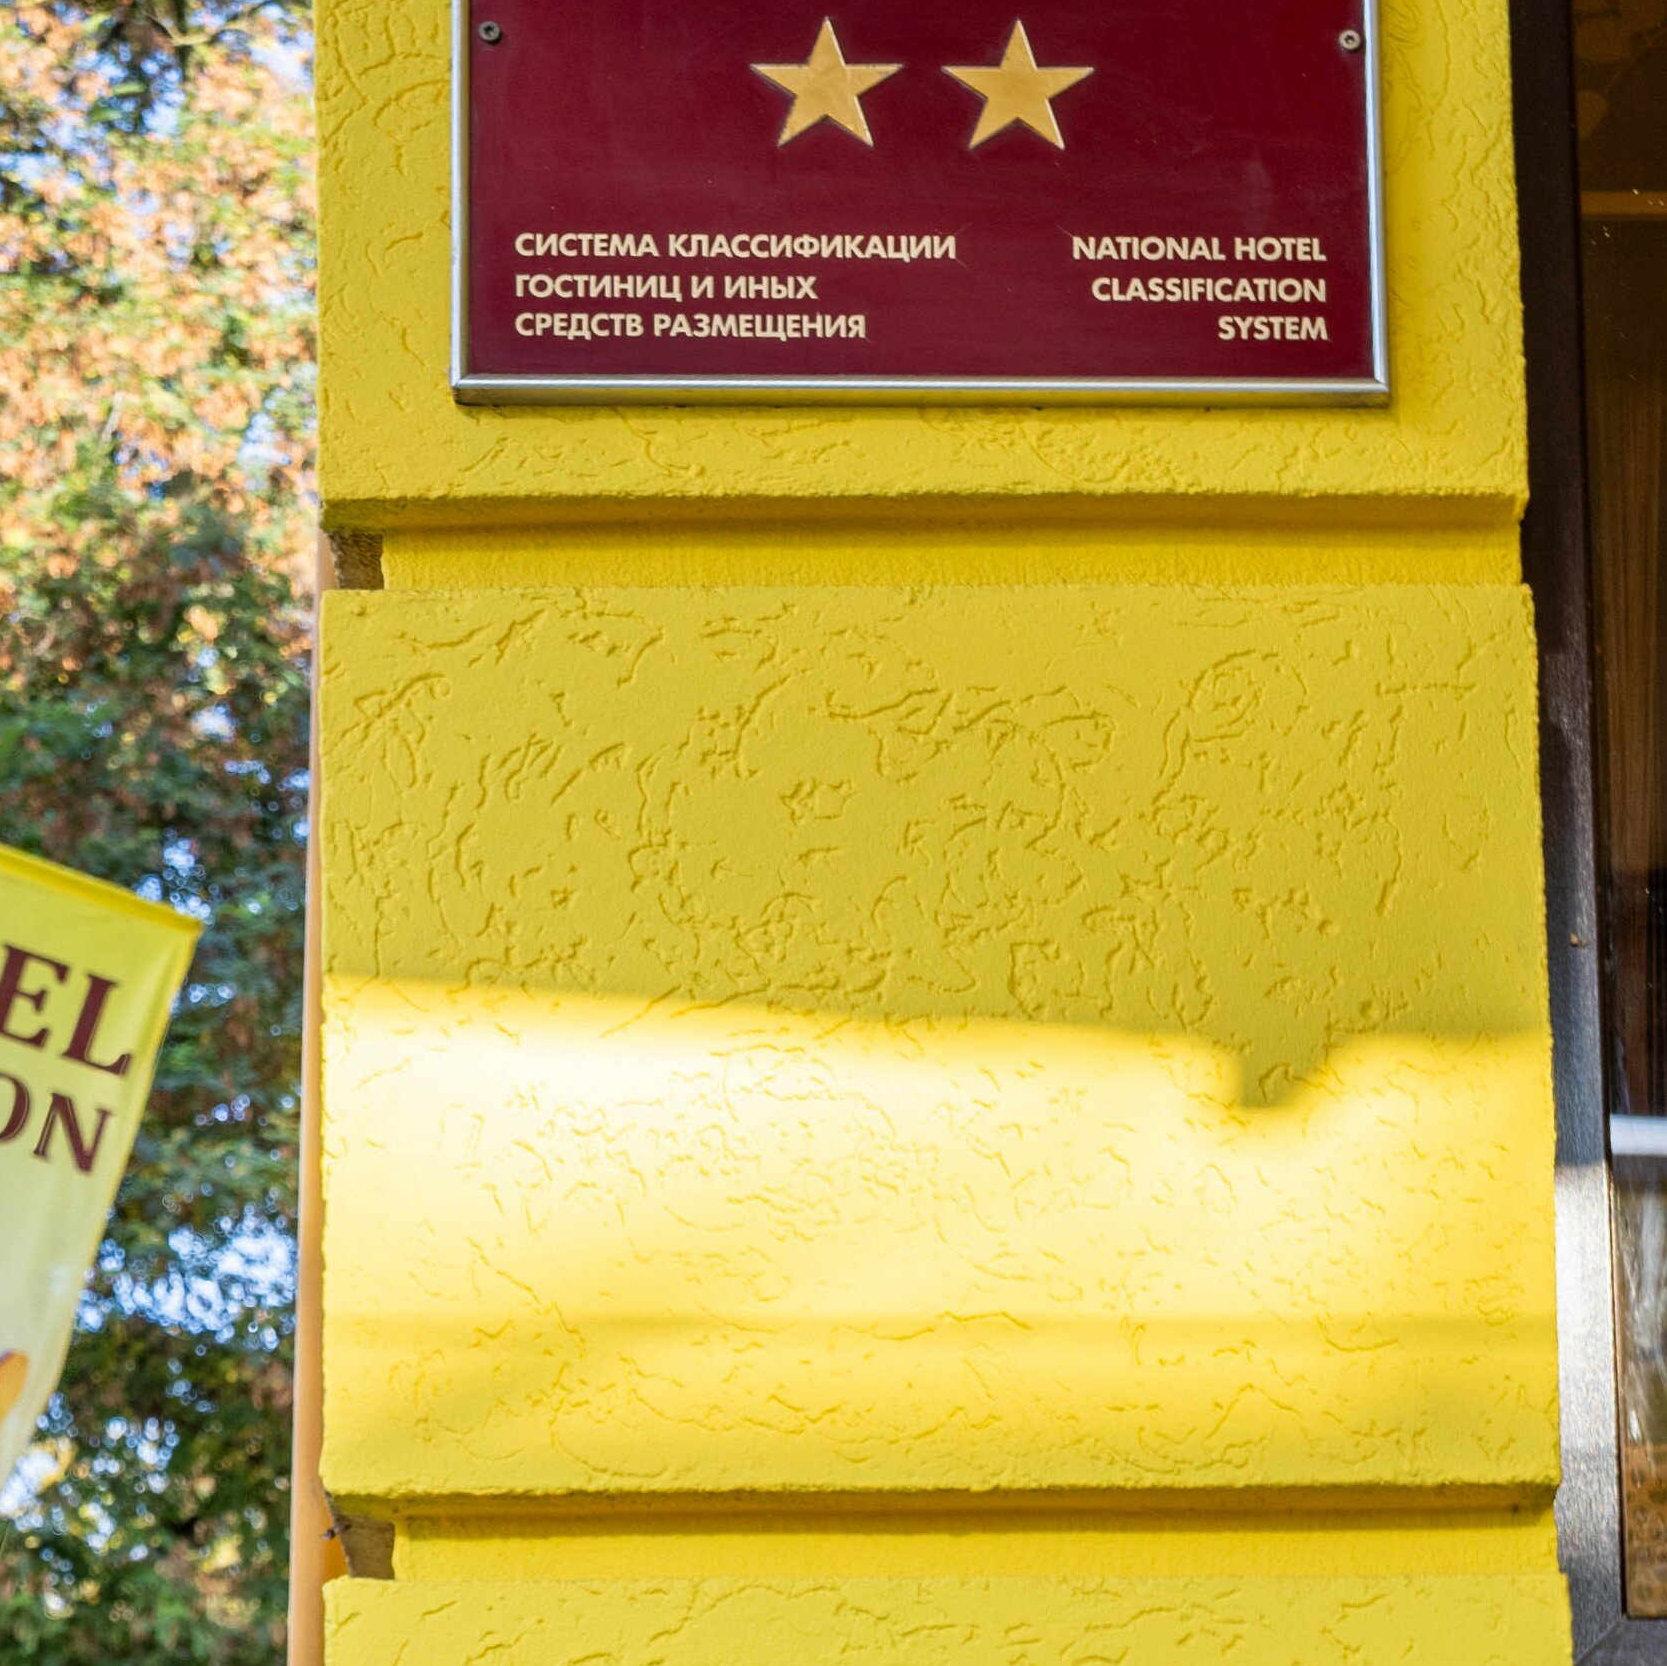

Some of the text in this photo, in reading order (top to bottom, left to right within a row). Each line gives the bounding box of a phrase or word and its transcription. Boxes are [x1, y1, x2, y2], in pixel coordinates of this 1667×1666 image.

[515, 233, 957, 263] СИСТЕМА КЛАССИФИКАЦИИ
[1072, 236, 1327, 262] NATIONAL HOTEL
[515, 274, 819, 302] ГОСТИНИЦ И ИНЫХ
[1092, 277, 1327, 303] CLASSIFICATION
[515, 312, 866, 342] СРЕДСТВ РАЗМЕЩЕНИЯ
[1218, 316, 1329, 341] SYSTEM
